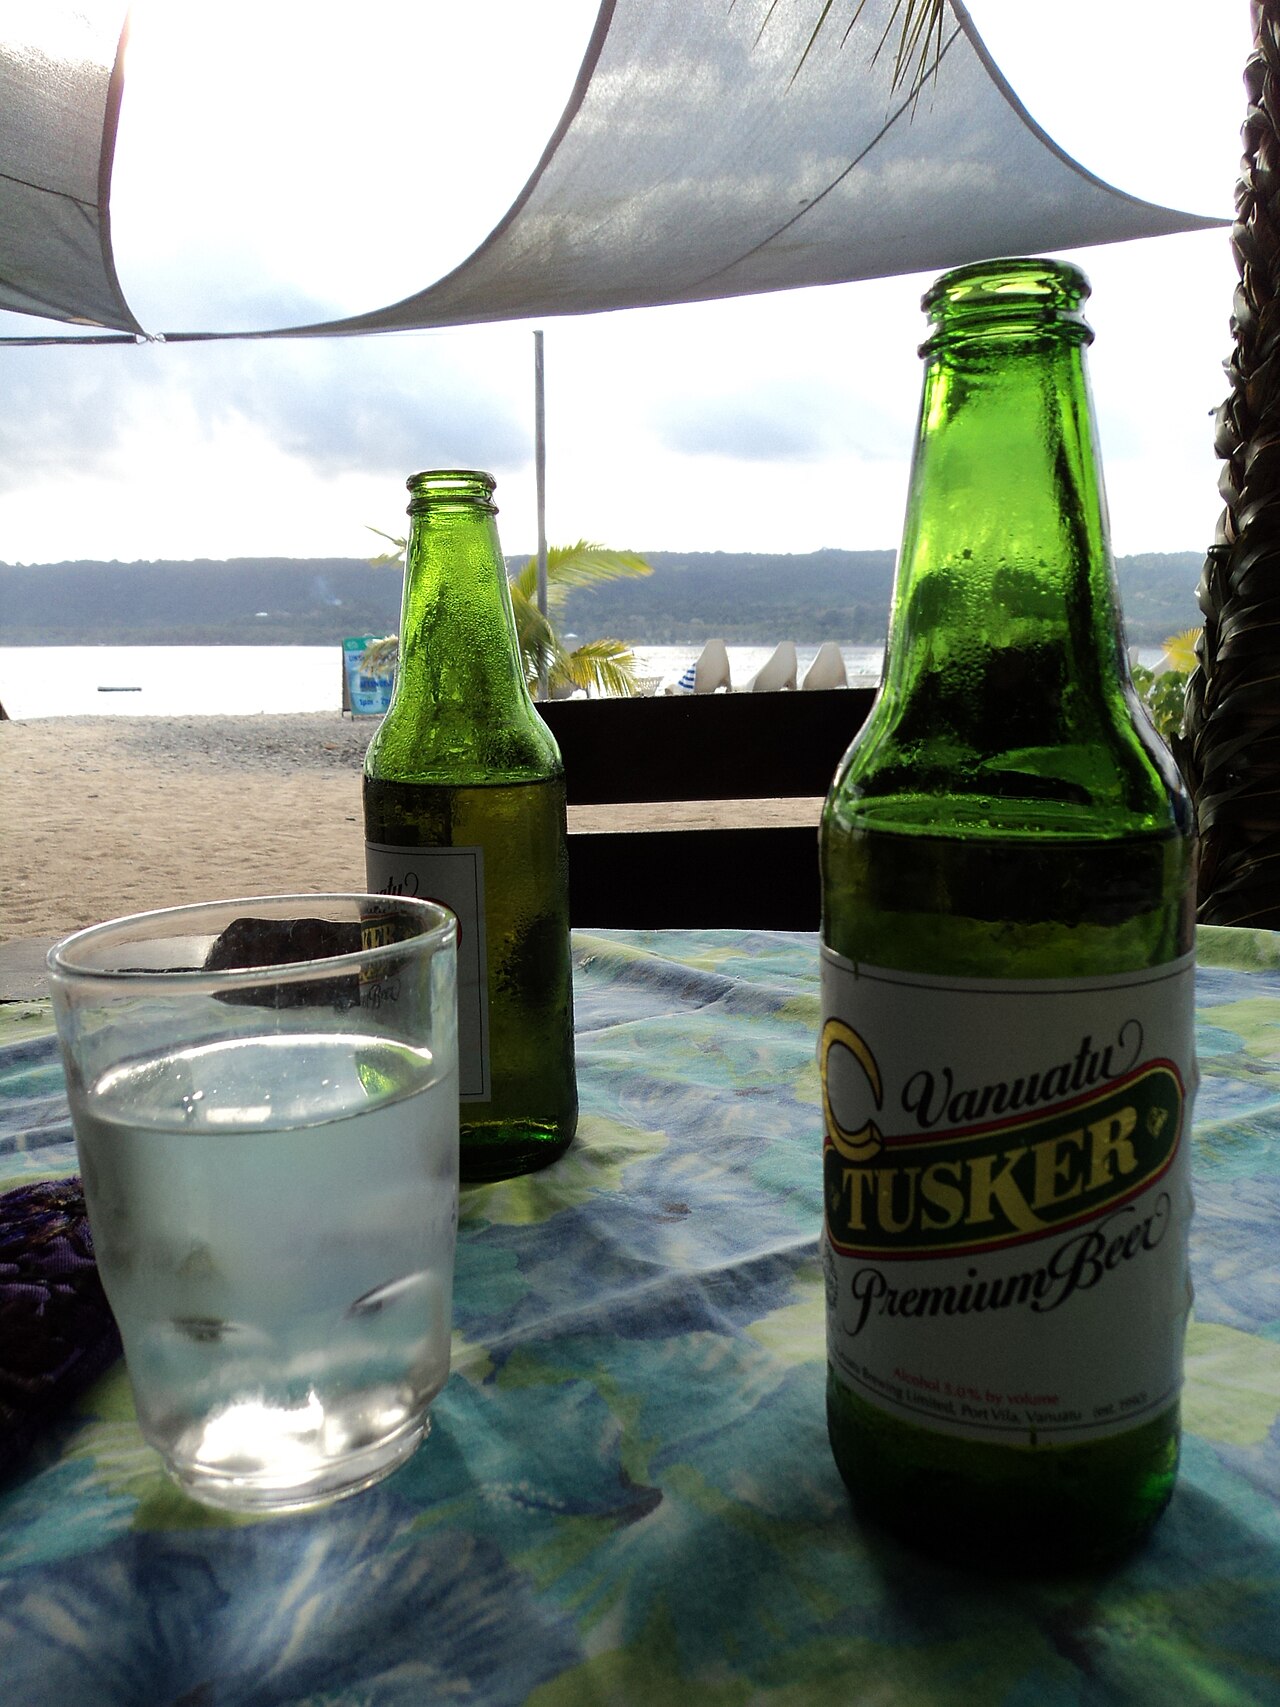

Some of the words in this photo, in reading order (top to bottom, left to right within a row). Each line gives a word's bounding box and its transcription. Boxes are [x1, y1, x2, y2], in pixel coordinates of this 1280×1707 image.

[902, 1019, 1144, 1128] Vanuatu
[842, 1105, 1139, 1234] TUSKER
[844, 1267, 1048, 1336] Premium
[1031, 1192, 1171, 1313] Beer
[893, 1367, 940, 1392] Alcohol
[985, 1389, 1003, 1405] by
[1007, 1392, 1059, 1406] volume
[961, 1405, 989, 1420] Port
[1026, 1409, 1083, 1424] Vanuatu
